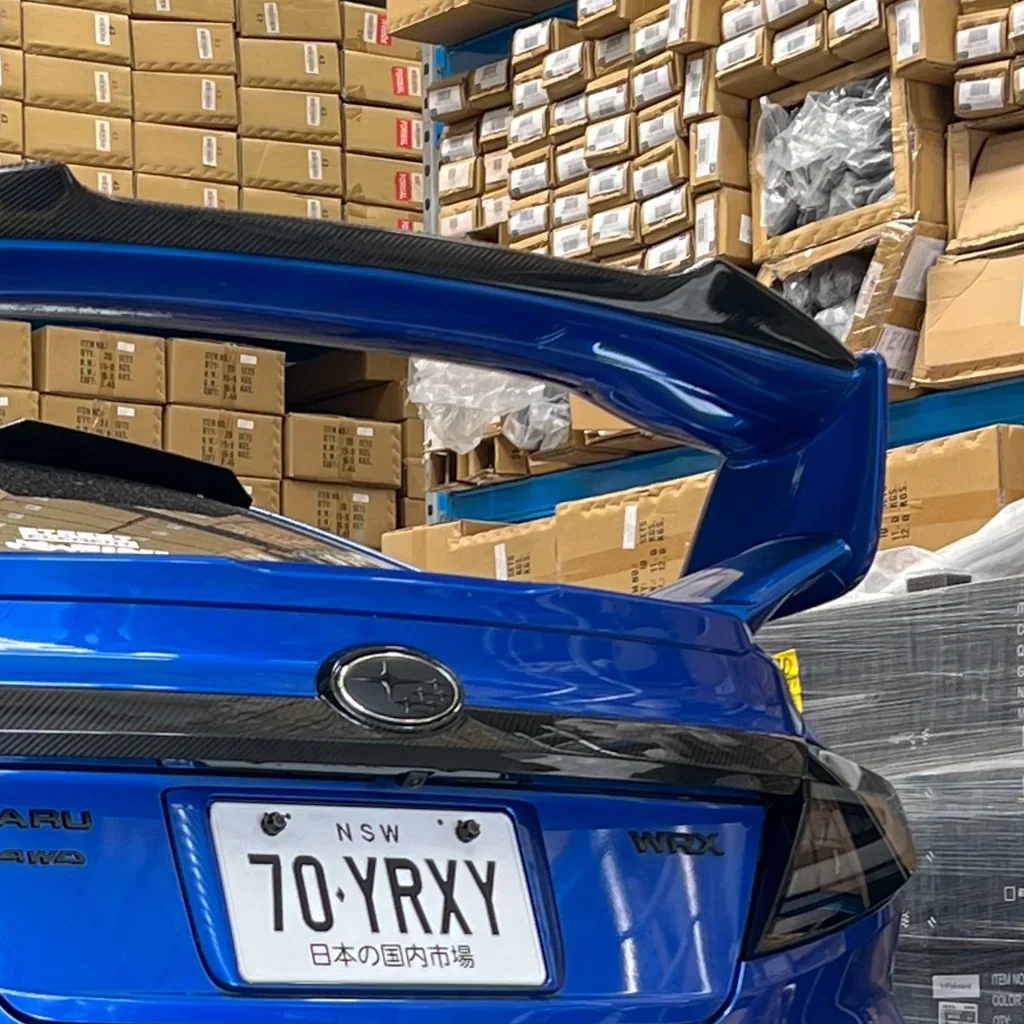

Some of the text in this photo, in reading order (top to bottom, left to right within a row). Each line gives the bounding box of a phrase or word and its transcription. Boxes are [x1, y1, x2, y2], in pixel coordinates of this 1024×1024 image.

[336, 823, 400, 843] NSW
[627, 830, 725, 857] WRX
[309, 943, 475, 969] 日本の国内市場
